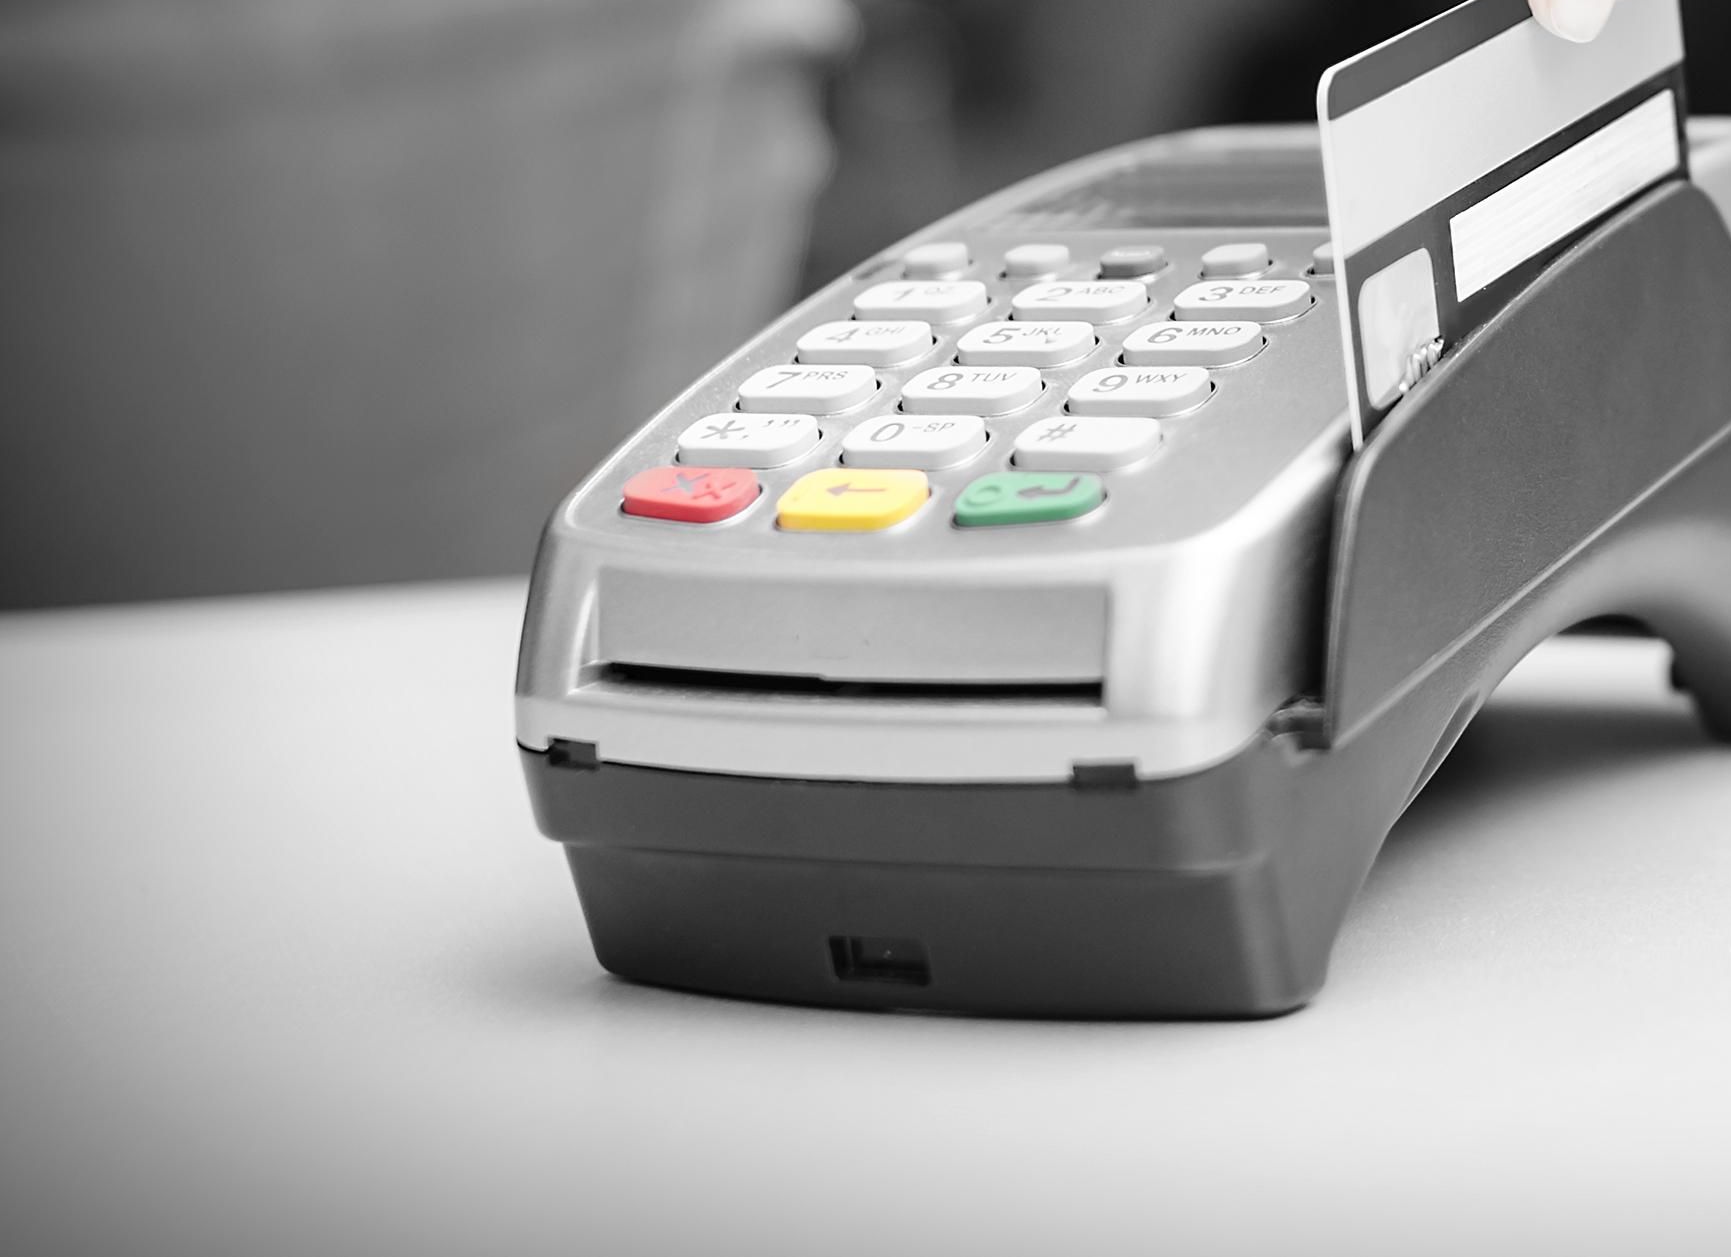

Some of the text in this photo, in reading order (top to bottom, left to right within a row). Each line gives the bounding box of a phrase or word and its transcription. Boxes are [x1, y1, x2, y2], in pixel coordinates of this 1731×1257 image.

[889, 285, 916, 302] 1
[1034, 285, 1127, 302] 2 ABC
[1197, 284, 1288, 302] 3 DEF
[825, 326, 907, 343] 4 GHI
[982, 327, 1021, 345] 5
[1146, 325, 1243, 345] 6 MNO
[765, 369, 849, 390] 7 PRS
[926, 371, 1018, 391] 8 TUV
[1091, 372, 1189, 393] 9 WXY
[870, 422, 905, 442] 0
[1036, 422, 1078, 442] #
